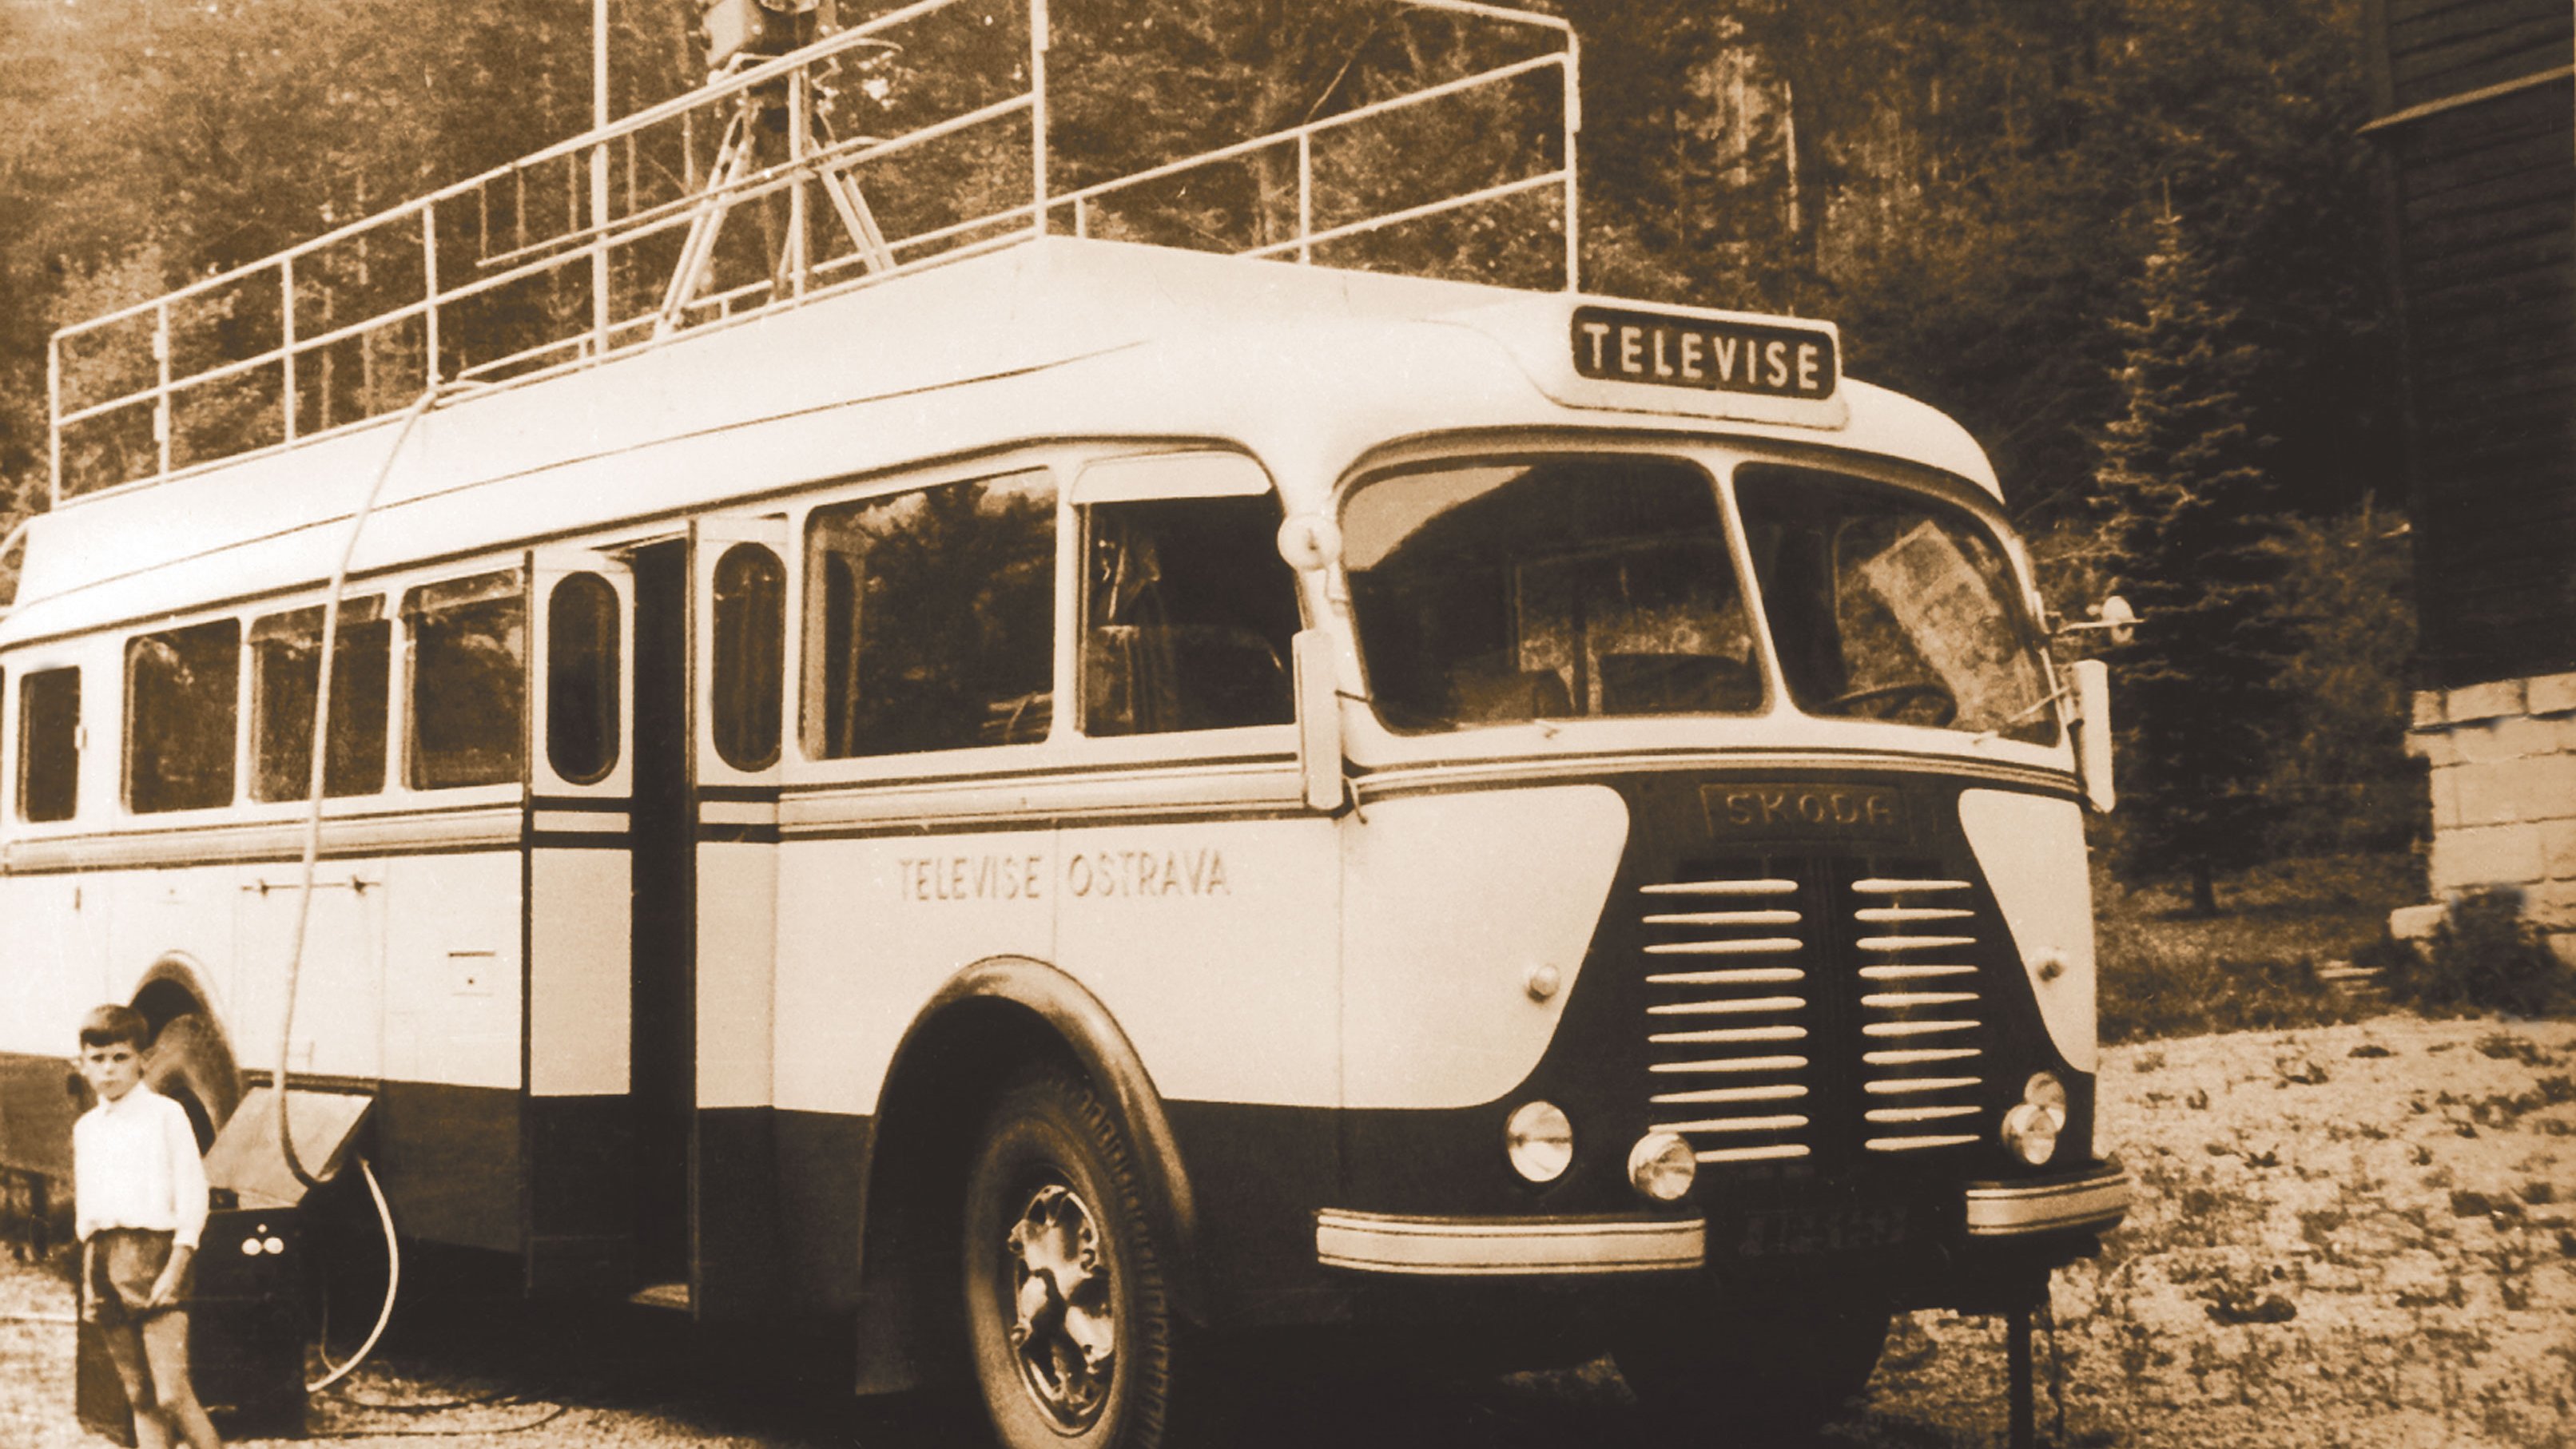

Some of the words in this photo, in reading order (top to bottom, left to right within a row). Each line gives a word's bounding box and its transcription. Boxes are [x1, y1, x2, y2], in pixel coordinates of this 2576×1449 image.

[1582, 323, 1819, 390] TELEVISE
[899, 854, 1043, 900] TELEVISE
[1067, 849, 1231, 896] OSTRAVA
